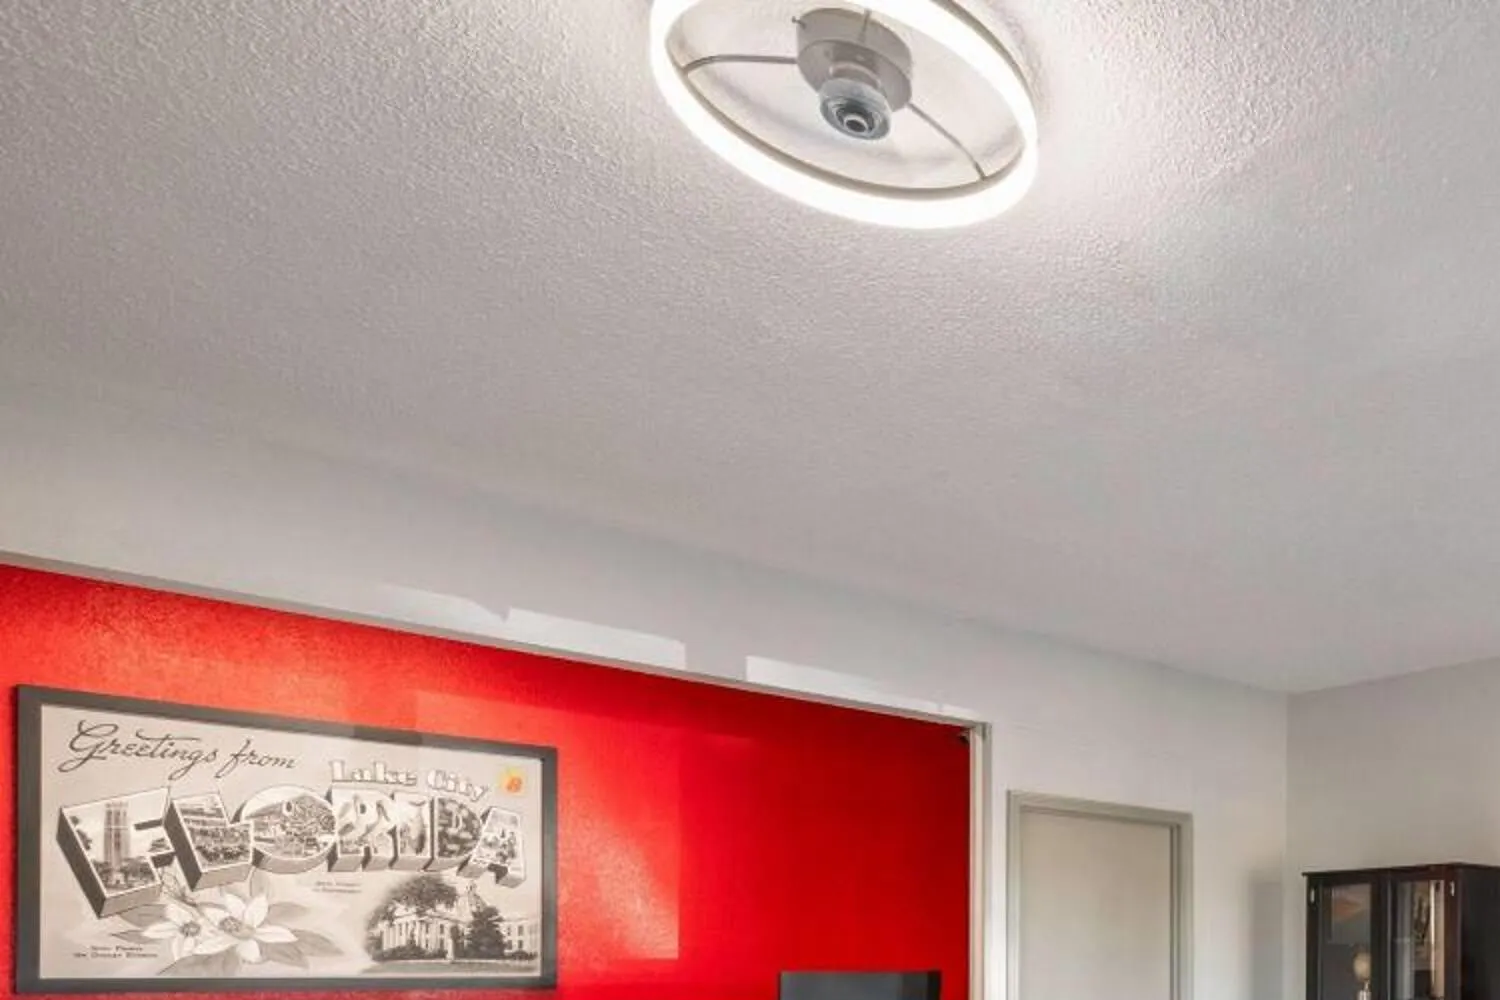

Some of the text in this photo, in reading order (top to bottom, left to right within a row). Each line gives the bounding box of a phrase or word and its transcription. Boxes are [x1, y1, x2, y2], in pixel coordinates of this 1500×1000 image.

[57, 719, 297, 781] Greetings from
[329, 760, 490, 803] Lake City
[56, 783, 528, 920] FLORIDA
